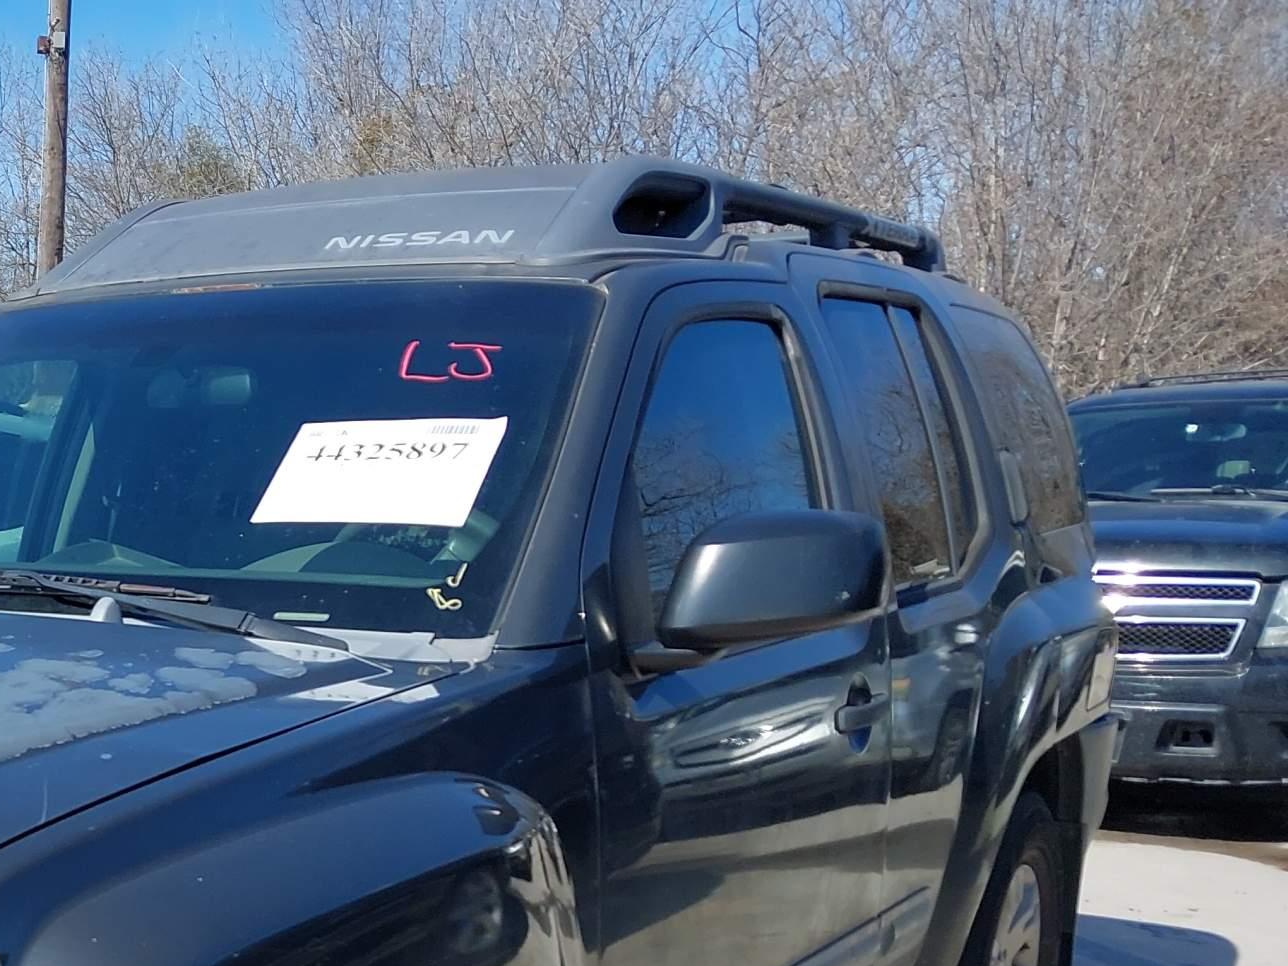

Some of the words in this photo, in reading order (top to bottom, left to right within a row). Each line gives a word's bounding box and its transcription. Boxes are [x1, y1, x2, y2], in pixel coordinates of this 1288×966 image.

[324, 230, 515, 250] NISSAN
[399, 339, 503, 382] LJ
[306, 442, 469, 462] 44325897
